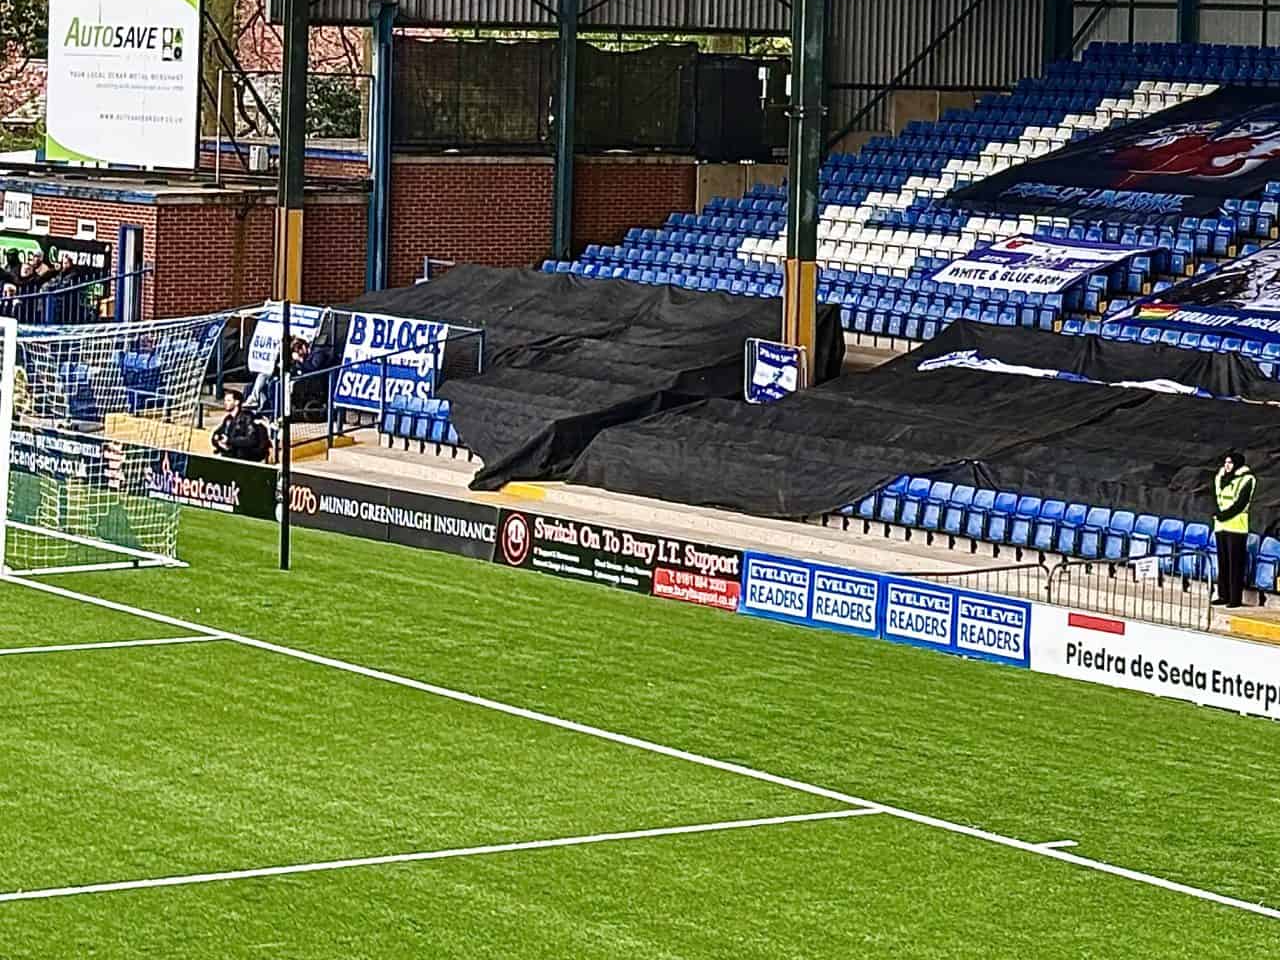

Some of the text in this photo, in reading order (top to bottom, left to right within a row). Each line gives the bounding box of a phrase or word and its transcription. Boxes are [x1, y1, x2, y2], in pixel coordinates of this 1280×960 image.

[950, 267, 986, 281] WHITE
[988, 269, 997, 281] &
[1000, 270, 1032, 283] BLUE
[253, 335, 279, 349] BURY
[351, 314, 367, 345] B
[370, 318, 443, 353] BLOCK
[318, 495, 497, 542] MUNRO GREENHALGH INSURANCE
[534, 517, 577, 545] Switch
[580, 525, 601, 549] On
[602, 529, 620, 554] To
[622, 533, 657, 565] Bury
[684, 544, 739, 576] Support
[751, 564, 807, 585] EYELEVEL
[817, 577, 876, 597] EYELEVEL
[750, 583, 805, 611] READERS
[815, 596, 873, 623] READERS
[890, 590, 950, 610] EYELEVEL
[889, 610, 948, 638] READERS
[960, 603, 1023, 625] EYELEVEL
[960, 623, 1021, 653] READERS
[1066, 642, 1126, 675] Piedra
[1130, 654, 1154, 680] de
[1158, 660, 1207, 690] Seda
